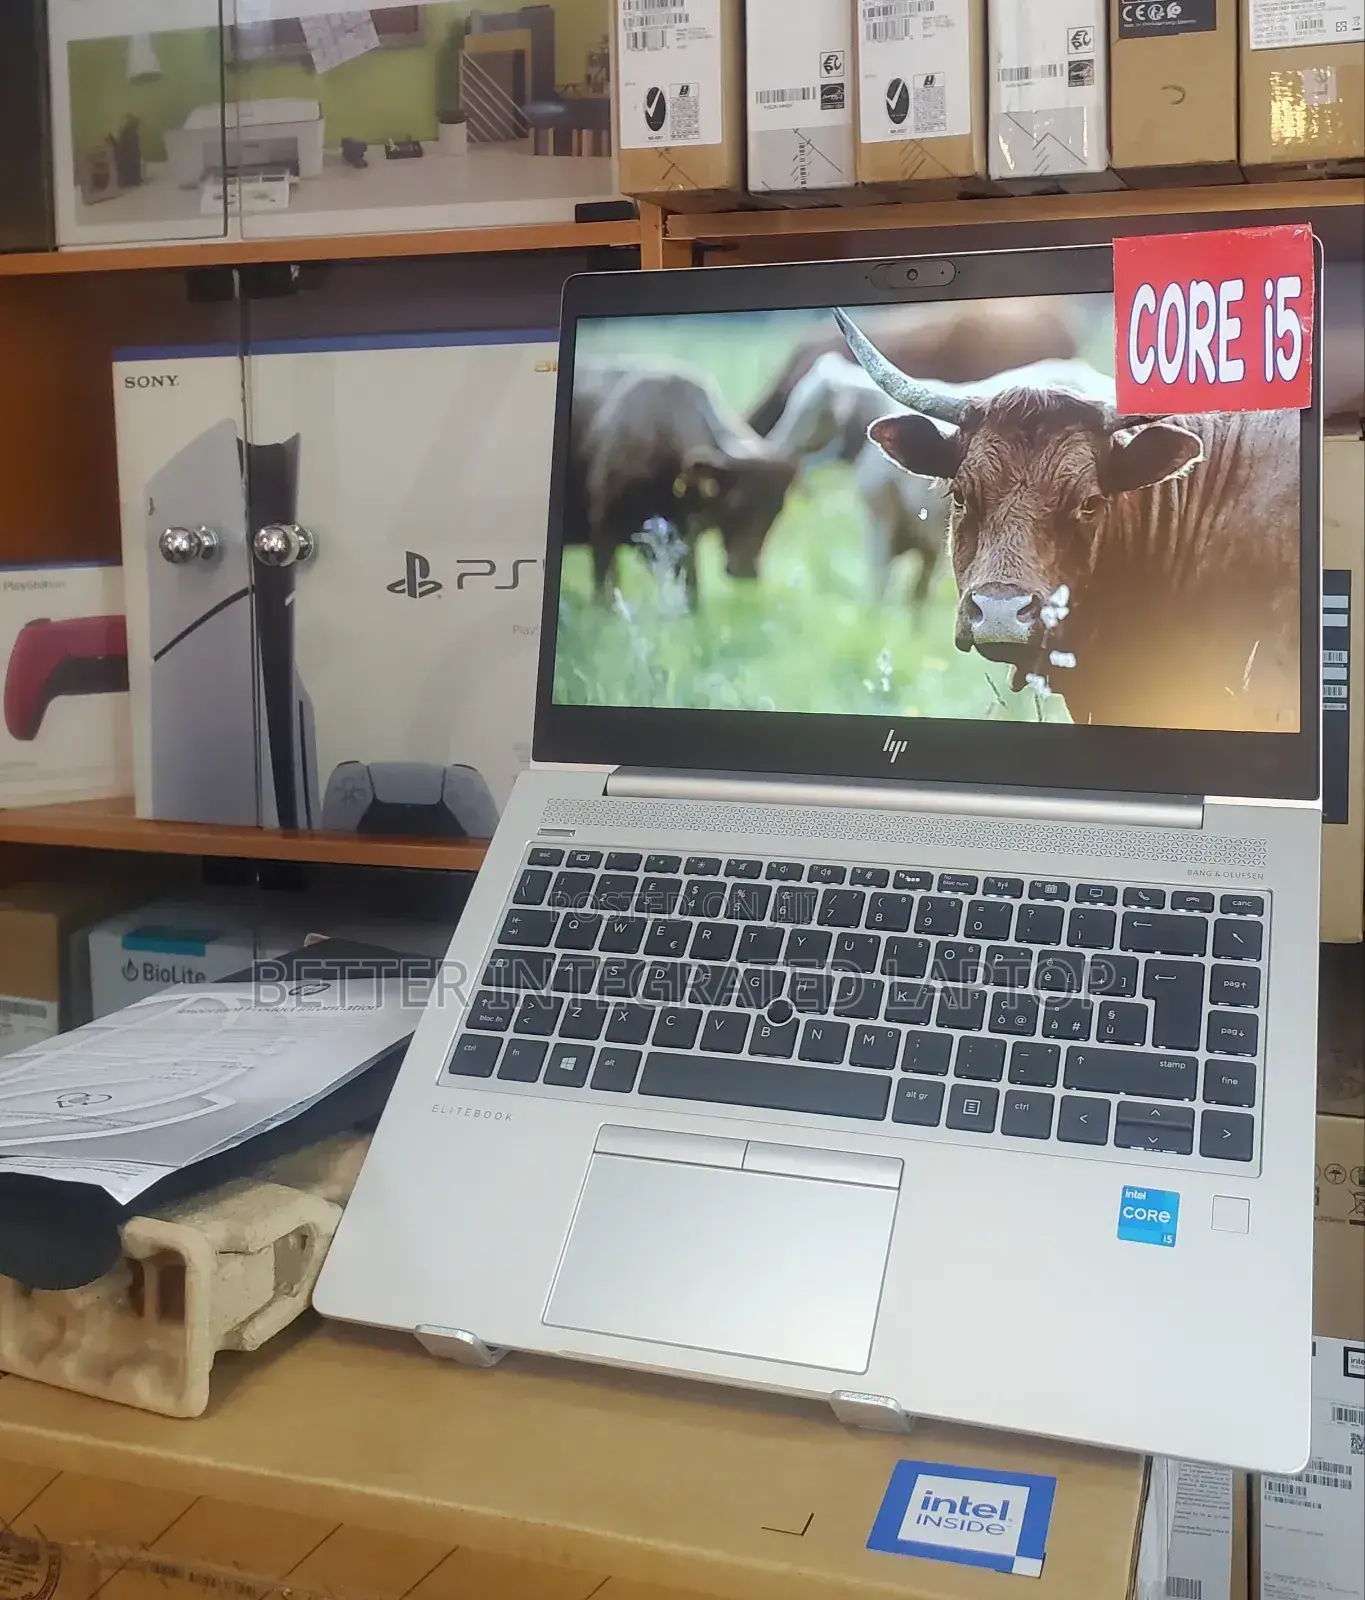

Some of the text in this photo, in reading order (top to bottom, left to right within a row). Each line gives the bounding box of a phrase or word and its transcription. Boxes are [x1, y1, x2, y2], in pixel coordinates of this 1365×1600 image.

[1128, 276, 1303, 385] CORE i5
[124, 374, 178, 390] SONY
[456, 559, 545, 590] PS
[883, 729, 908, 763] hp
[1187, 869, 1212, 878] BANG
[1223, 871, 1265, 880] OLUFSEN
[649, 882, 656, 891] £
[692, 886, 699, 895] $
[557, 891, 562, 899] 1
[599, 893, 608, 902] 2
[644, 897, 651, 905] 3
[688, 900, 695, 908] 4
[1232, 899, 1253, 908] canc
[733, 903, 741, 912] 5
[779, 906, 787, 915] 6
[826, 909, 836, 918] 7
[875, 913, 883, 922] 8
[1028, 909, 1035, 919] ?
[569, 920, 579, 930] Q
[924, 917, 932, 926] 9
[614, 923, 627, 933] W
[656, 926, 666, 936] E
[702, 930, 712, 940] R
[748, 933, 757, 943] T
[669, 940, 678, 949] €
[798, 937, 807, 947] Y
[844, 941, 854, 951] U
[944, 950, 956, 960] O
[995, 954, 1003, 963] P
[142, 961, 207, 984] BioLite
[610, 966, 619, 976] S
[655, 970, 665, 979] D
[702, 974, 712, 983] F
[750, 977, 760, 987] G
[798, 981, 808, 991] H
[1223, 979, 1241, 990] pag
[846, 986, 855, 996] J
[898, 992, 907, 1001] K
[949, 996, 957, 1006] L
[572, 1007, 583, 1018] Z
[618, 1011, 629, 1022] X
[1108, 1010, 1116, 1020] §
[666, 1016, 676, 1026] C
[715, 1020, 725, 1030] V
[1015, 1016, 1027, 1026] @
[1072, 1022, 1081, 1031] #
[761, 1027, 771, 1037] B
[812, 1029, 822, 1040] N
[1221, 1027, 1237, 1037] pag
[863, 1034, 875, 1046] M
[464, 1044, 477, 1052] ctrl
[512, 1048, 520, 1056] fn
[605, 1059, 615, 1067] alt
[1159, 1059, 1186, 1071] stamp
[1221, 1076, 1239, 1086] fine
[918, 1092, 928, 1100] gr
[1015, 1102, 1030, 1111] ctrl
[432, 1104, 514, 1122] ELITEBOOK
[1125, 1190, 1147, 1200] intel
[920, 1490, 1011, 1522] intel
